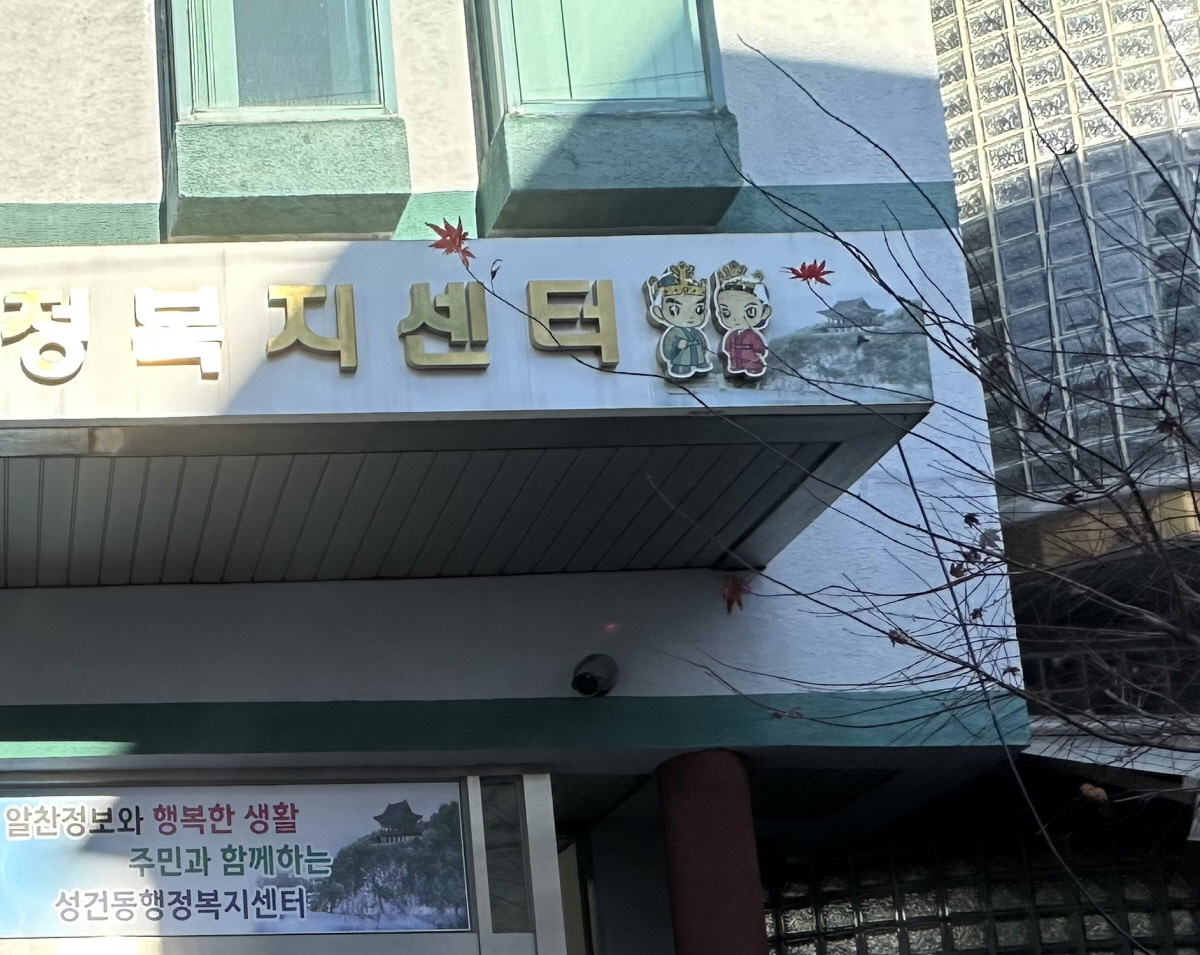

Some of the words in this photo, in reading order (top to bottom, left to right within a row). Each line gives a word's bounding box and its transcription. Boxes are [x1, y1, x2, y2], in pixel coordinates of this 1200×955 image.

[5, 804, 144, 838] 알찬정보와
[152, 801, 236, 836] 행복한
[243, 800, 300, 835] 생활
[128, 844, 212, 877] 주민과
[220, 842, 333, 877] 함께하는
[54, 885, 307, 923] 성건동행정복지센터
